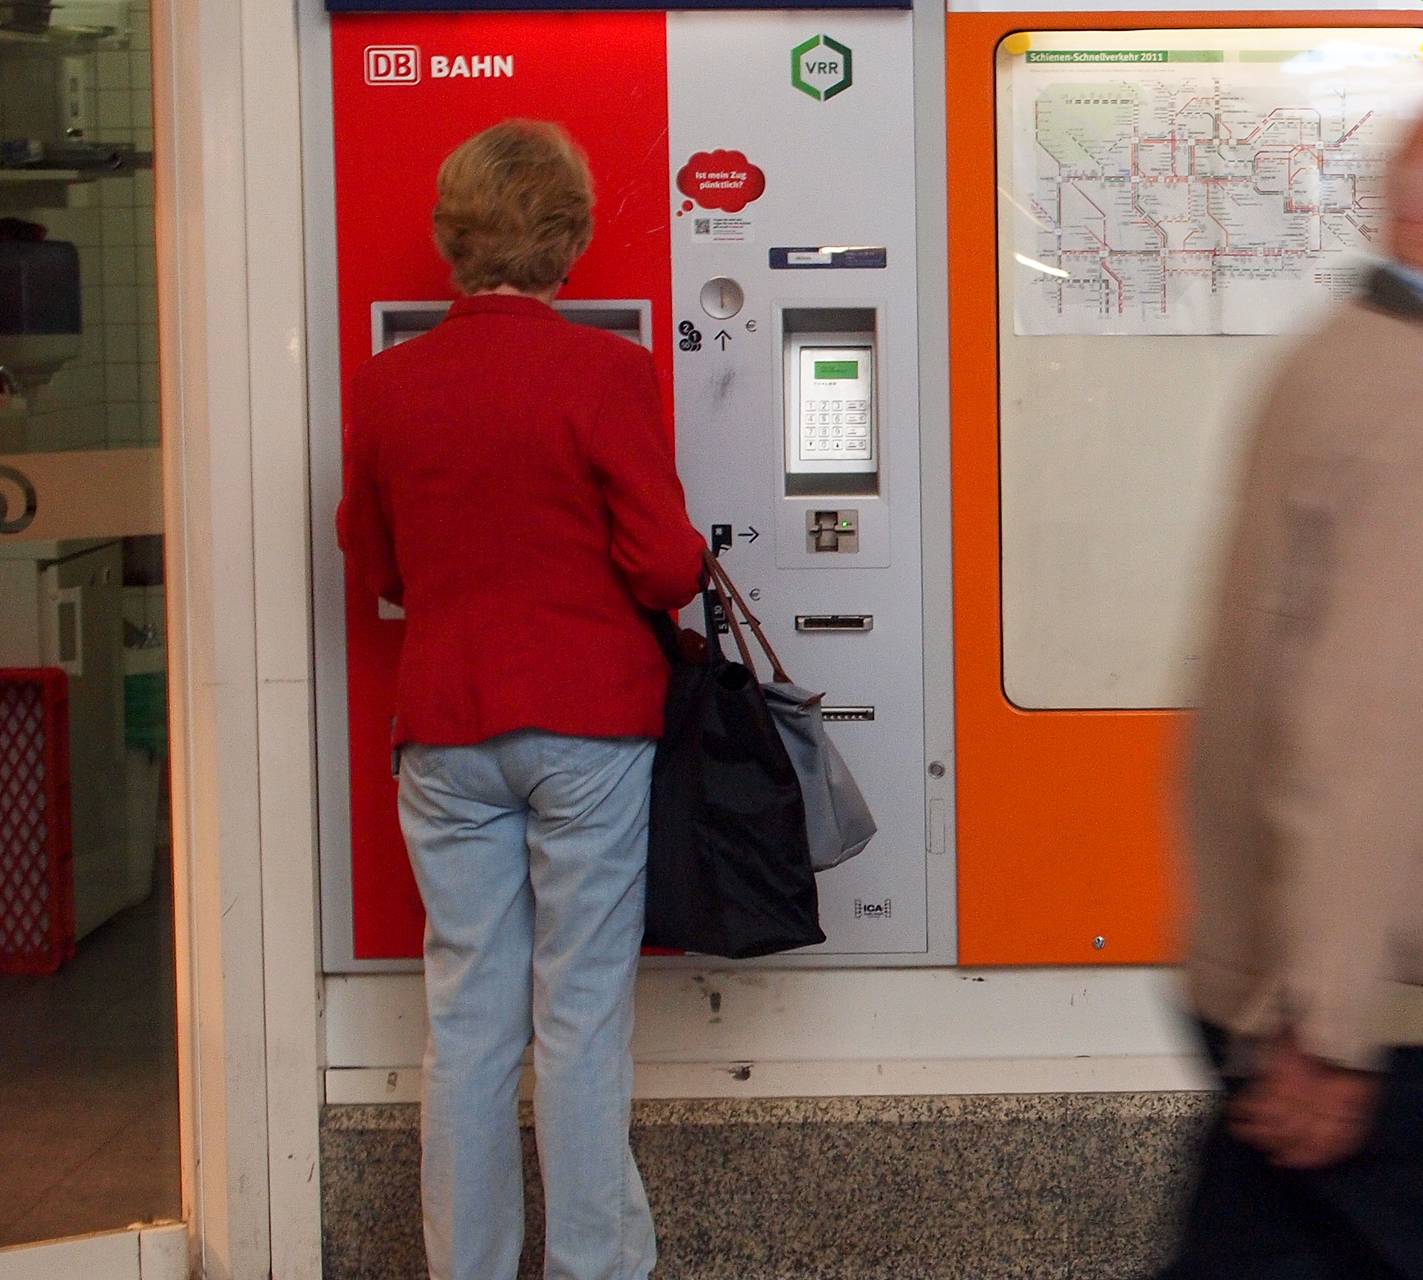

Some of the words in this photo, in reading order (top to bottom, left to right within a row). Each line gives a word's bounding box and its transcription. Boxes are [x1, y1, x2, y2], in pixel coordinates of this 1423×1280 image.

[1030, 52, 1139, 62] Schienen-Schnellverkehr
[1140, 52, 1164, 62] 2011
[371, 51, 415, 79] DB
[430, 55, 514, 78] BAHN
[805, 61, 838, 74] VRR
[863, 904, 883, 912] ICA
